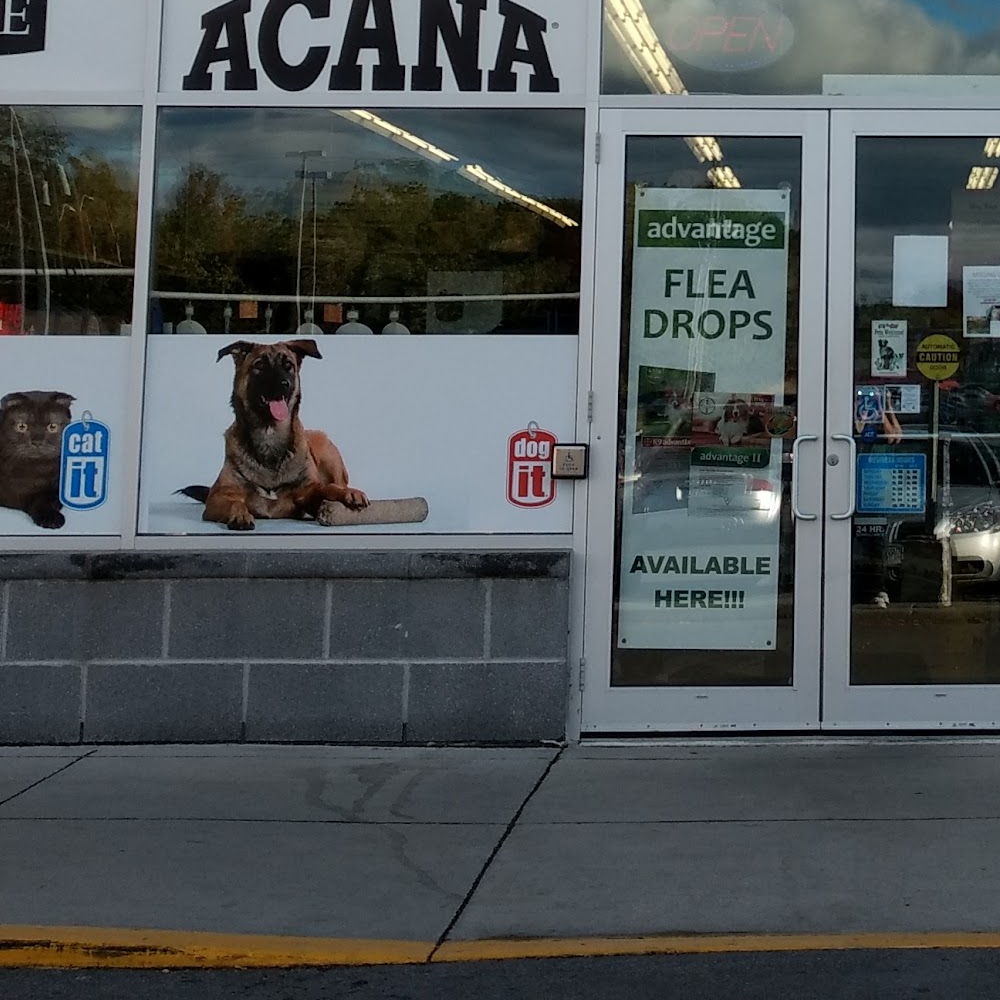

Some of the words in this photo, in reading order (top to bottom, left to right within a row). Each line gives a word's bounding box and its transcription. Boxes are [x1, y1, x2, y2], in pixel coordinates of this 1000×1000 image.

[669, 15, 784, 53] OPEN
[647, 216, 776, 247] advantage
[664, 269, 756, 299] FLEA
[643, 309, 773, 340] DROPS
[919, 352, 958, 362] CAUTION
[68, 430, 103, 454] cat
[514, 438, 550, 459] dog
[700, 451, 749, 464] advantage
[70, 461, 98, 497] it
[518, 465, 546, 497] it
[856, 525, 867, 533] 24
[630, 555, 771, 575] AVAILABLE
[654, 590, 745, 609] HERE!!!
